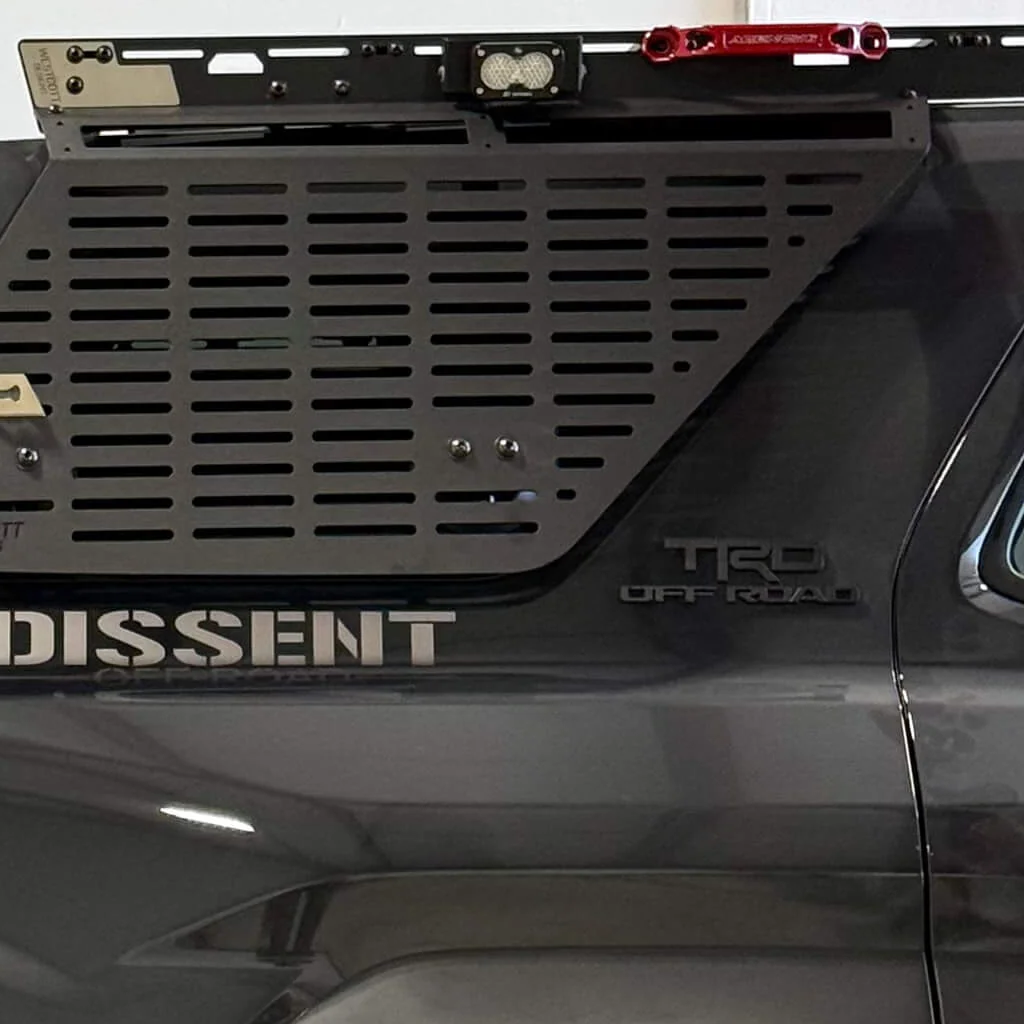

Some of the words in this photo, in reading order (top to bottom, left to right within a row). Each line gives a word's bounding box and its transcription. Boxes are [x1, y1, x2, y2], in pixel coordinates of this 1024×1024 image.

[664, 537, 825, 583] TRD
[620, 585, 717, 603] OFF
[726, 585, 862, 604] ROAD
